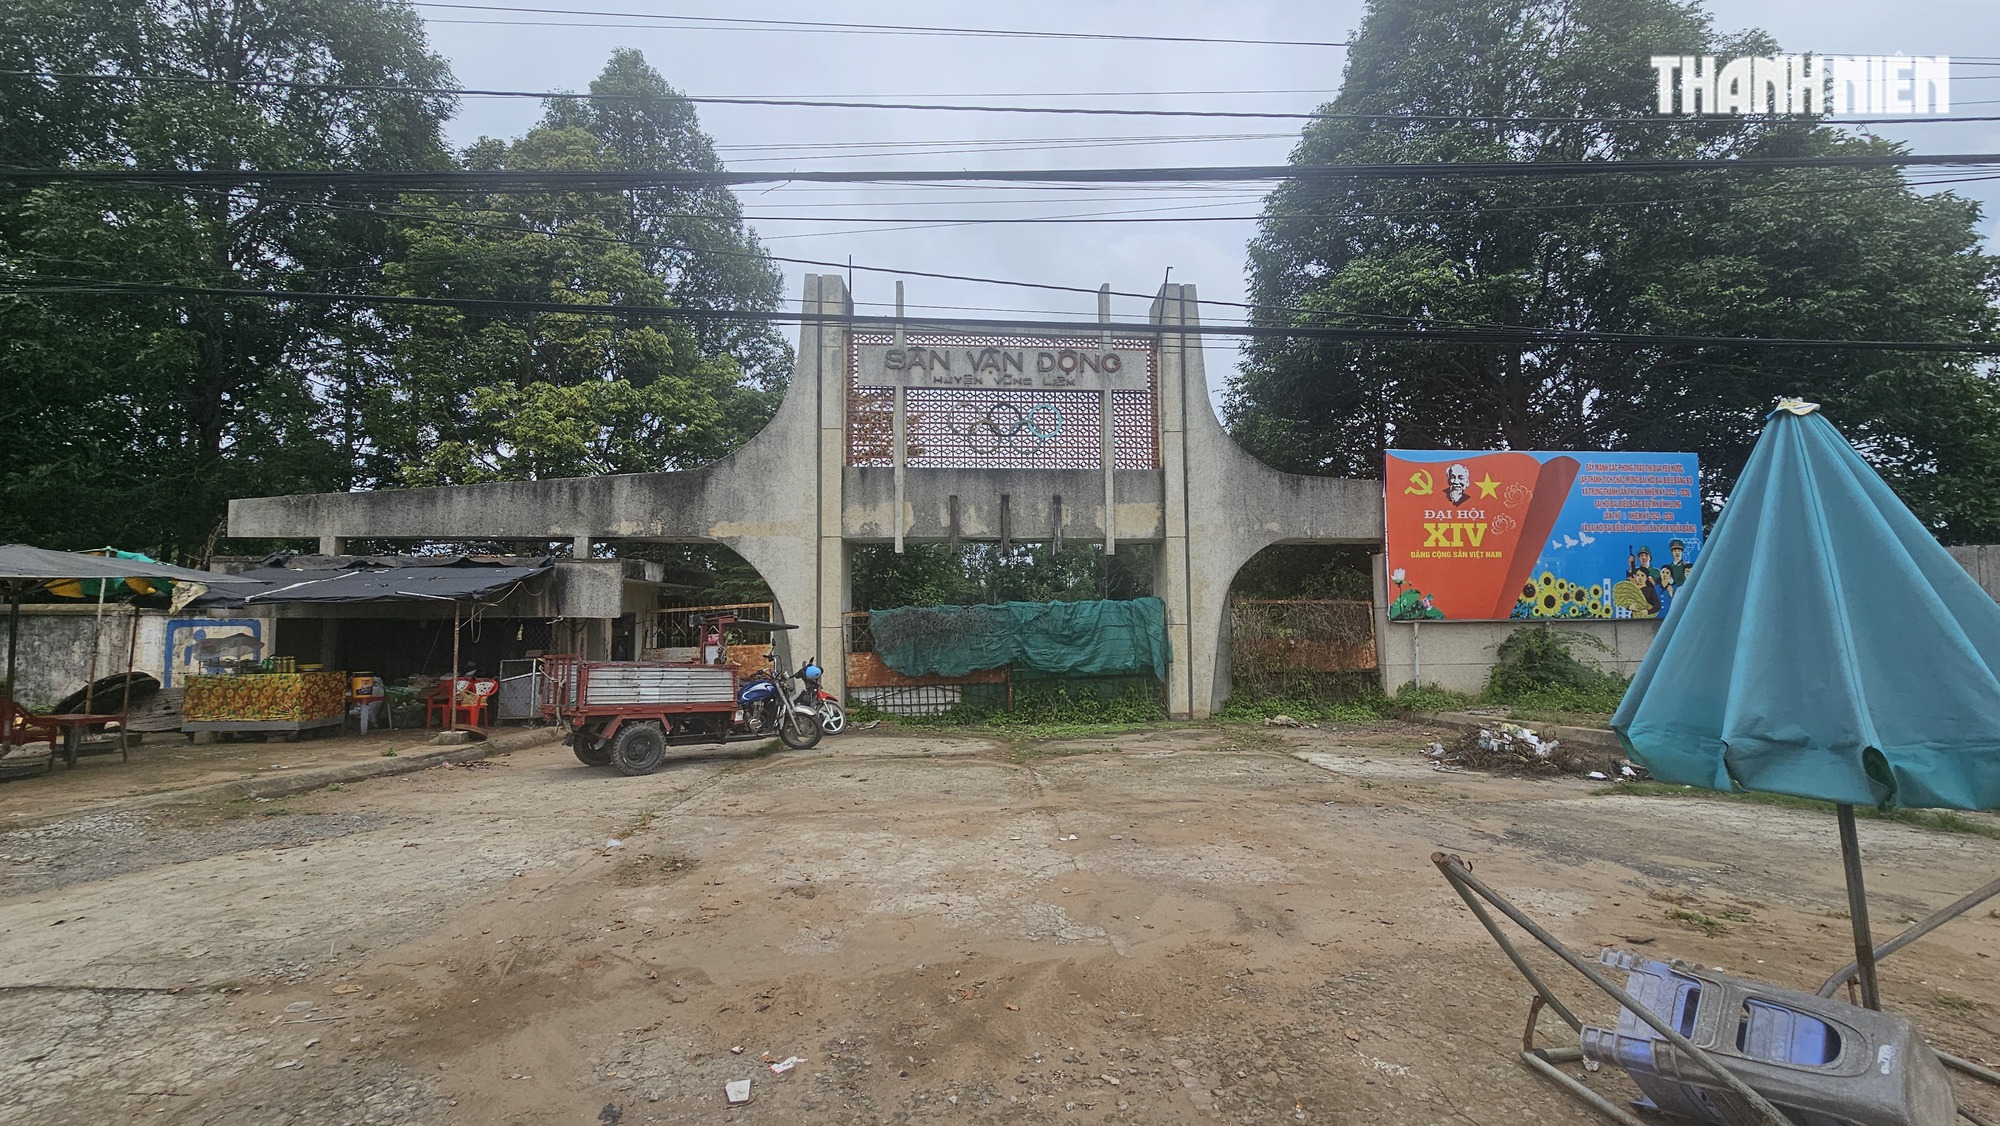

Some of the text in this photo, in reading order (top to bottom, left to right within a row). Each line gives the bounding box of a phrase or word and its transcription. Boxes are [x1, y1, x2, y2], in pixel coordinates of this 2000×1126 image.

[966, 347, 1023, 374] VẬN
[1037, 350, 1120, 376] ĐỘNG
[933, 374, 1075, 387] HUYỆN VŨNG LIÊM
[1588, 475, 1603, 483] THÀNH
[1666, 488, 1677, 496] 2025
[1660, 499, 1670, 508] VĨNH
[1671, 500, 1682, 508] LONG
[1424, 508, 1485, 521] ĐẠI HỘI
[1649, 512, 1660, 520] 2025
[1663, 512, 1675, 520] 2030
[1424, 523, 1487, 547] XIV
[1432, 551, 1451, 559] CỘNG
[1469, 550, 1484, 559] VIỆT
